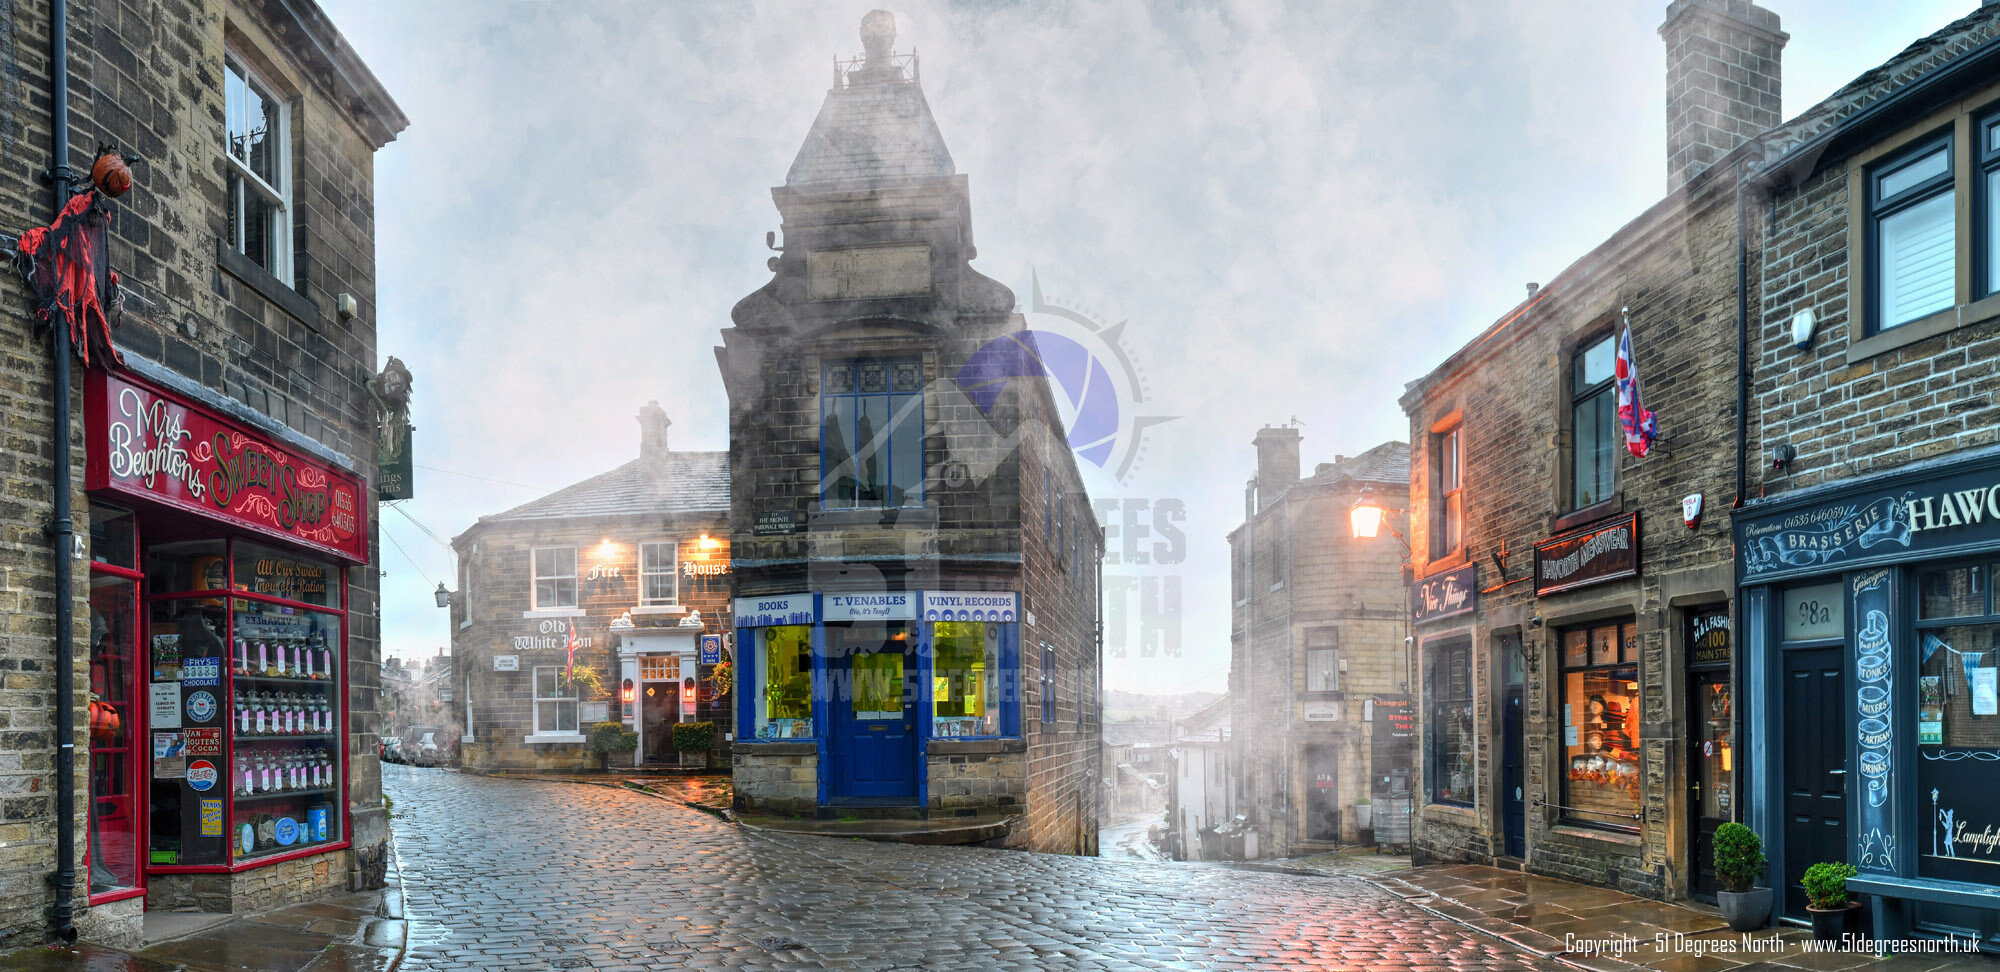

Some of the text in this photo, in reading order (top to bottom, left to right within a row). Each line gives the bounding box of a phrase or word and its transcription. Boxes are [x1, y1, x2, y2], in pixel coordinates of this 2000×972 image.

[120, 388, 191, 441] Mrs
[110, 422, 205, 499] Beightons
[209, 431, 326, 530] SWEET SHOP
[335, 489, 352, 511] 01535
[1746, 506, 1844, 538] Reservations 01535 646059
[1789, 506, 1879, 549] BRASSERIE
[1542, 550, 1580, 581] HAWORTH
[1580, 527, 1628, 567] MENSWEAR
[257, 559, 274, 576] All
[276, 561, 293, 577] Our
[587, 561, 727, 580] Free House
[297, 578, 325, 593] Ration
[833, 596, 906, 606] T. VENABLES
[928, 596, 1012, 607] VINYL RECORDS
[1416, 574, 1469, 618] Nice Things
[758, 601, 788, 611] BOOKS
[540, 620, 566, 634] Old
[514, 636, 558, 651] White
[1602, 636, 1610, 653] &
[1709, 631, 1726, 648] 100
[1696, 650, 1714, 660] MAIN
[1862, 663, 1887, 679] TONICS
[1862, 700, 1887, 713] MIXERS
[184, 729, 202, 738] VAN
[1865, 730, 1890, 744] ARTISAN
[1862, 761, 1887, 774] DRINKS
